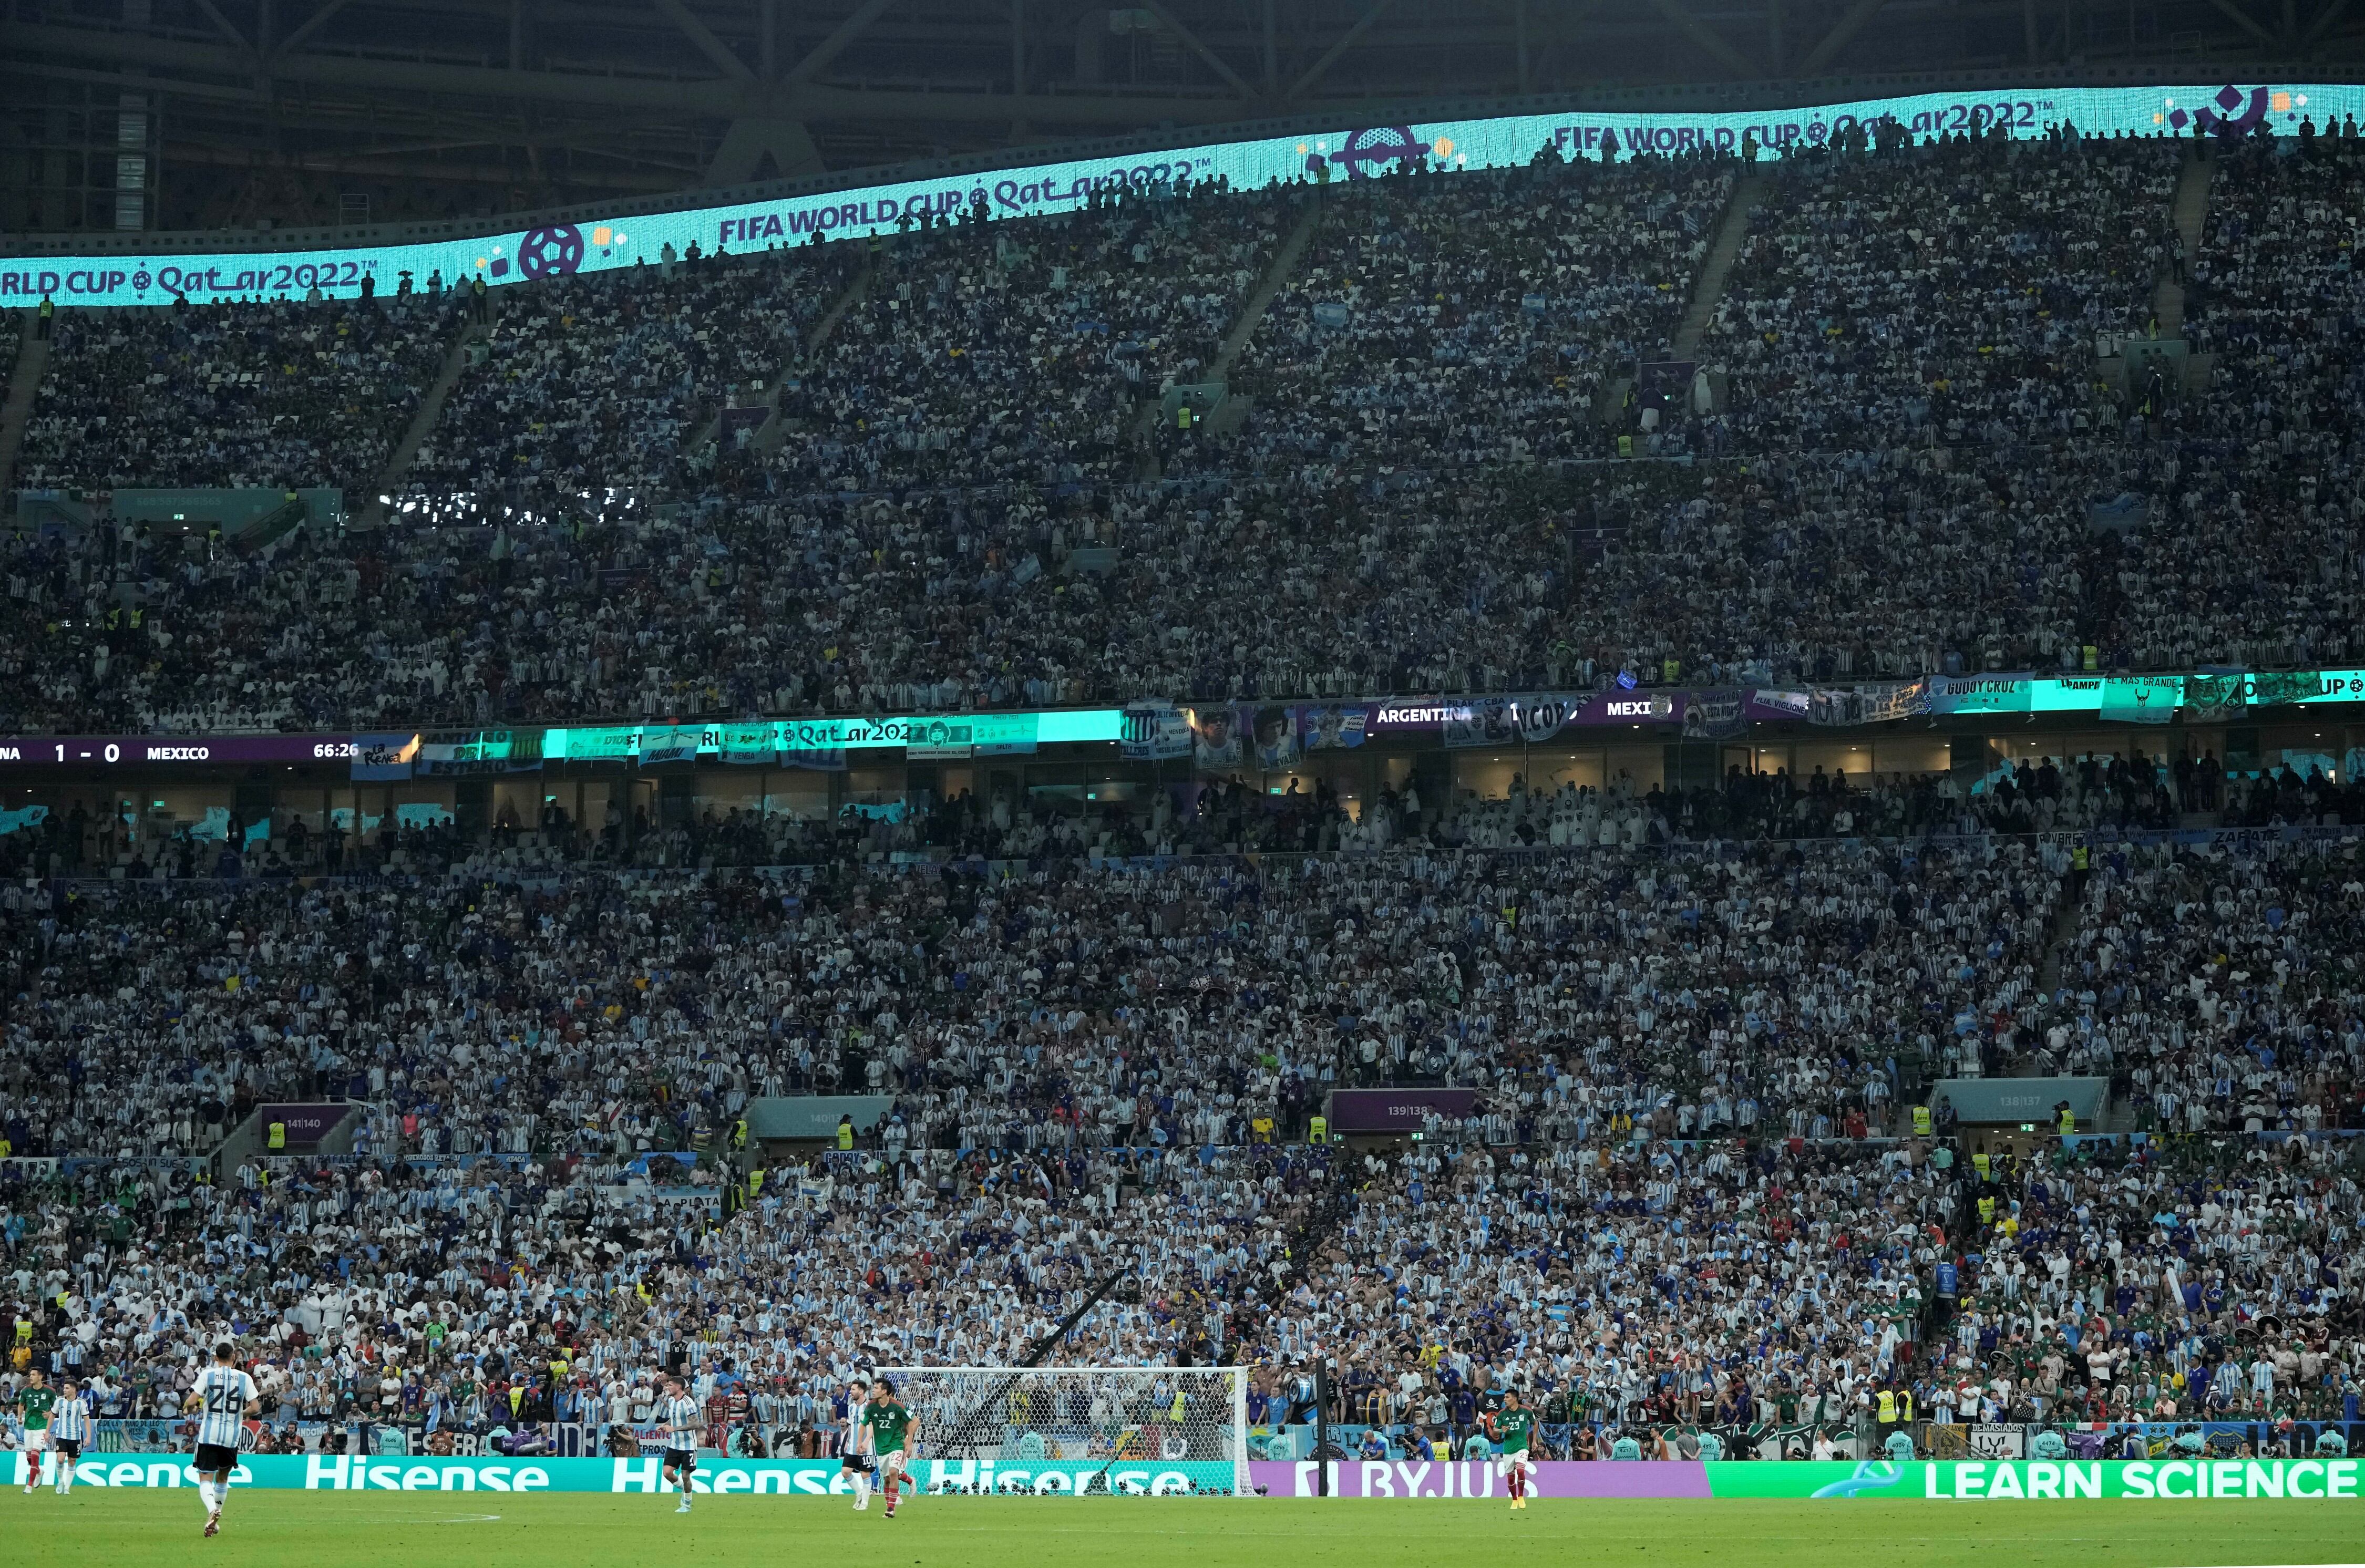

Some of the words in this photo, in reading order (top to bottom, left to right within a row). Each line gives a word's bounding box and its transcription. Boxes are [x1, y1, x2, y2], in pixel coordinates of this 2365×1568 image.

[1556, 126, 1620, 150] FIFA
[1626, 126, 1734, 151] WORLD
[719, 214, 784, 243] FIFA
[790, 201, 898, 234] WORLD
[904, 191, 962, 219] CUP
[67, 270, 126, 294] CUP
[1987, 679, 2015, 694] CRUZ
[2144, 677, 2177, 687] GRANDE
[2320, 679, 2345, 695] UP
[1485, 697, 1505, 706] CBA
[1607, 701, 1672, 715] MEXI
[1774, 700, 1805, 715] VIGLIONE
[1708, 706, 1721, 717] ESTA
[1722, 706, 1734, 717] VIDA
[55, 744, 65, 762] 1
[105, 744, 120, 762] 0
[147, 747, 210, 760] MEXICO
[313, 743, 359, 758] 66:26
[454, 747, 493, 759] DEL
[647, 747, 685, 761] MIAMI
[734, 751, 755, 760] VENGA
[430, 760, 506, 775] ESTERO
[287, 1118, 321, 1129] 141|140
[810, 1113, 844, 1123] 140|13
[122, 1158, 141, 1168] SOS
[160, 1158, 191, 1169] SUEO
[208, 1384, 241, 1414] 26
[879, 1419, 891, 1429] 22
[1509, 1421, 1520, 1430] 23
[1972, 1423, 2025, 1432] DEMASIADOS
[76, 1443, 81, 1456] 9
[689, 1453, 694, 1463] 7
[862, 1456, 871, 1466] 10
[891, 1452, 900, 1461] 22
[305, 1454, 550, 1492] Hisense
[931, 1459, 1190, 1497] Hisense
[1371, 1461, 1539, 1498] BYJU'S
[1926, 1462, 2101, 1498] LEARN
[2122, 1460, 2358, 1498] SCIENCE
